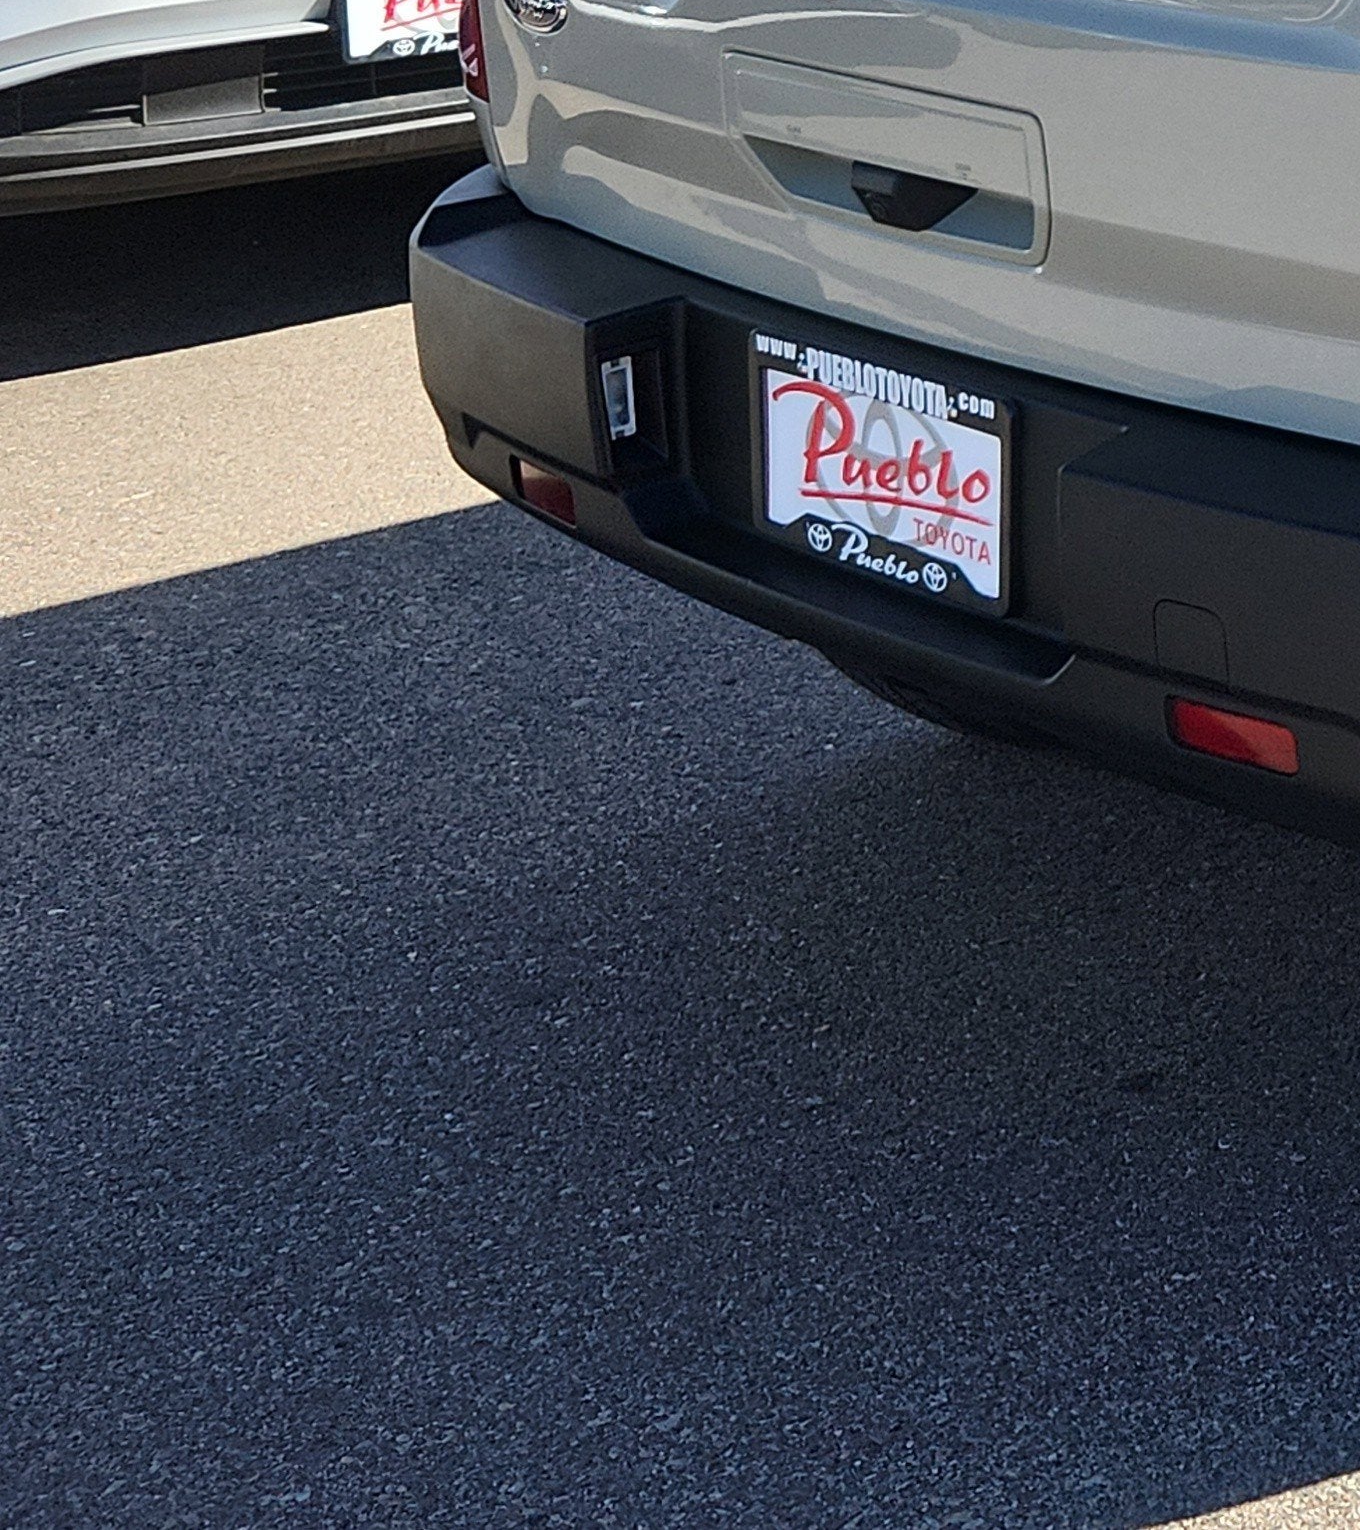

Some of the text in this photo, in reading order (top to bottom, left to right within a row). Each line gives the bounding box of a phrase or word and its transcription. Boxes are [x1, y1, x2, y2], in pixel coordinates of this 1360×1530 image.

[772, 380, 991, 504] Pueblo
[832, 521, 920, 585] Pueblo
[913, 518, 992, 566] TOYOTA
